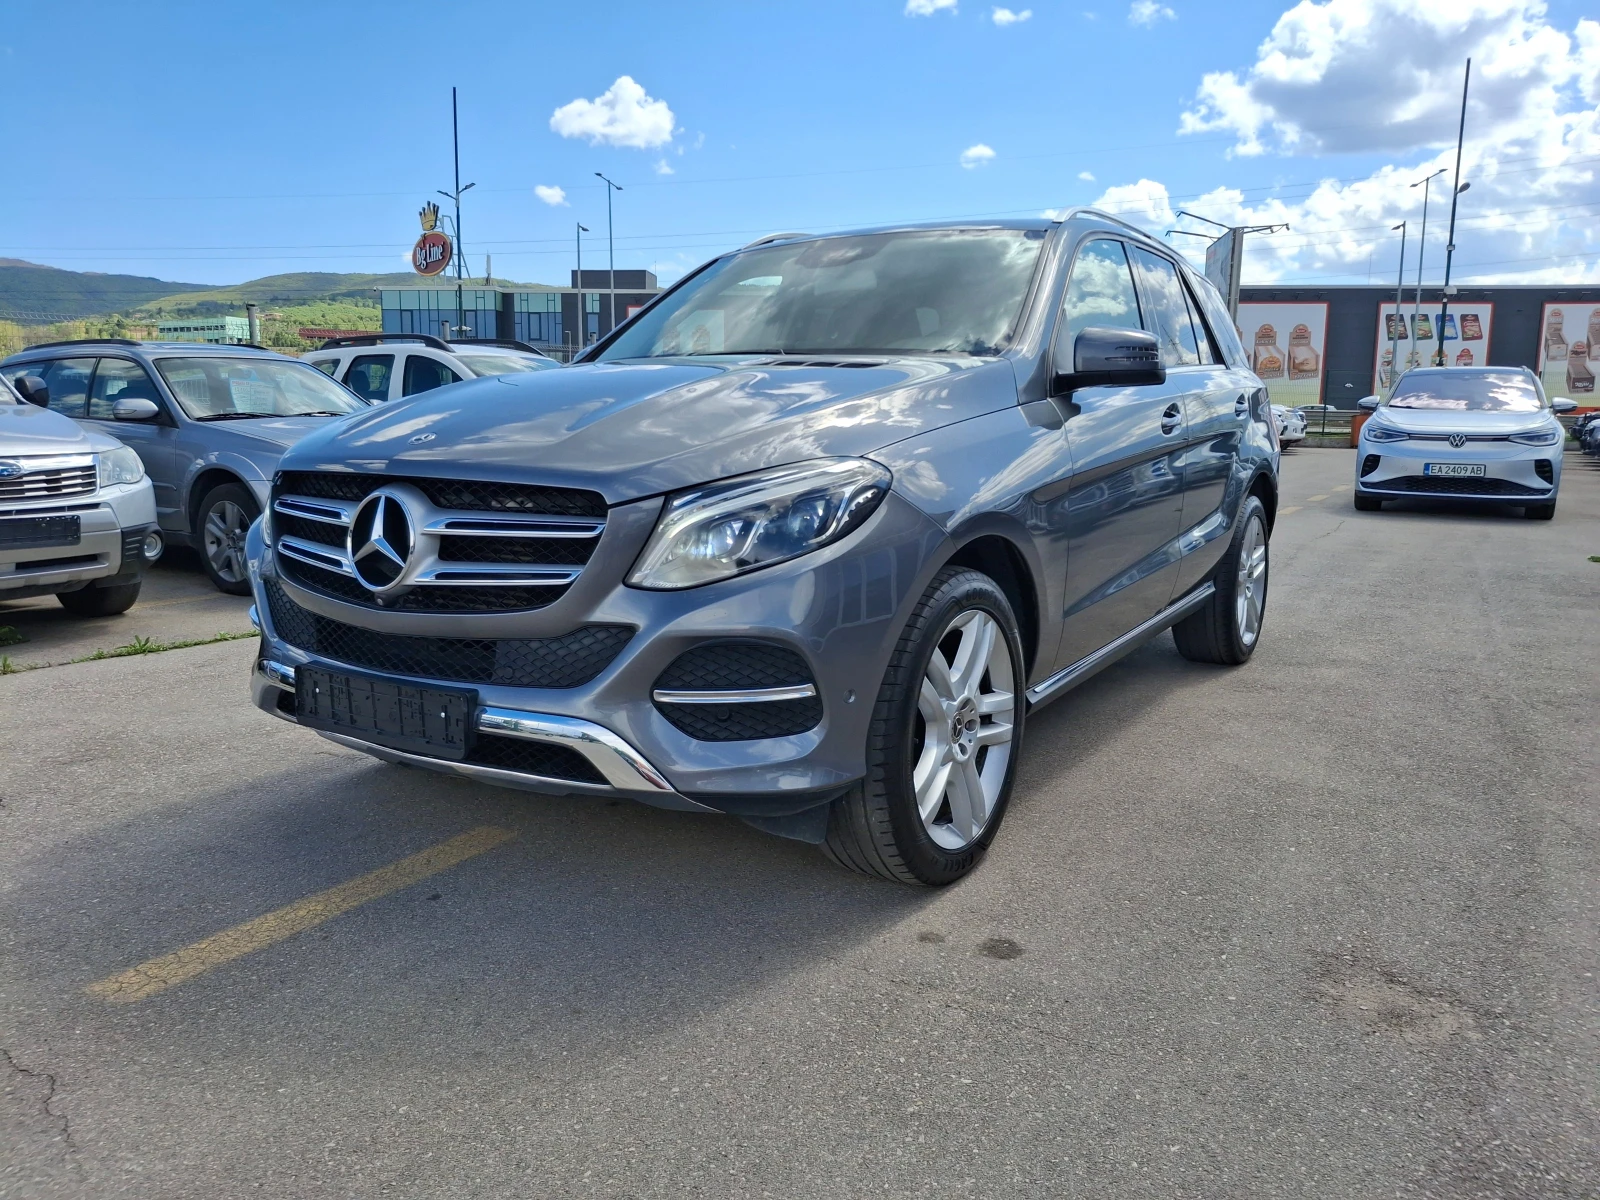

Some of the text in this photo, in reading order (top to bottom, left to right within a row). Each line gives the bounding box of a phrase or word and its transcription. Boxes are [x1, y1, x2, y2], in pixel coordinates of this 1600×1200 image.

[416, 242, 444, 269] Bg Line
[1430, 465, 1483, 475] EA 2409 AB
